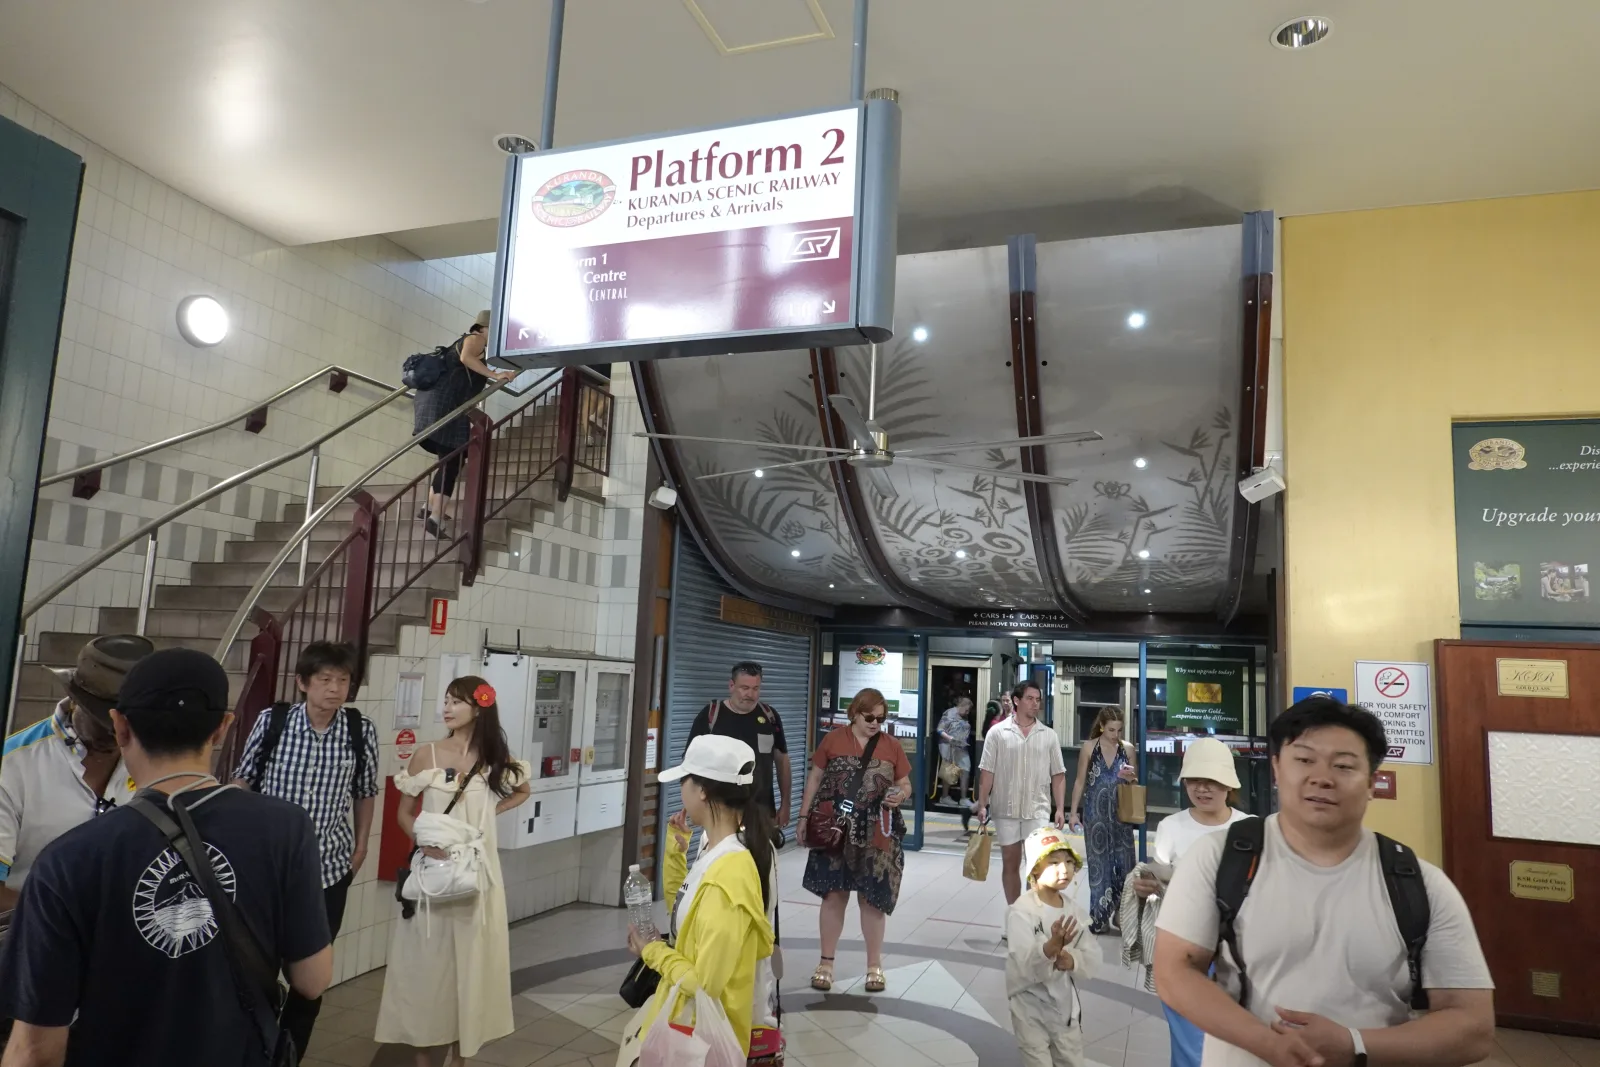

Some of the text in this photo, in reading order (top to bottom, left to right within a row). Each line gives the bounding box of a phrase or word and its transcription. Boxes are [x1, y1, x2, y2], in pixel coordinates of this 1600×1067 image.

[630, 128, 845, 191] Platform 2
[545, 171, 603, 190] KURANDA
[628, 172, 840, 210] KURANDA SCENIC RAILWAY
[627, 197, 783, 230] Departures & Arrivals
[583, 270, 626, 284] Centre
[589, 288, 628, 302] CENTRAL
[1482, 507, 1558, 526] Upgrade
[1090, 664, 1111, 674] 6007
